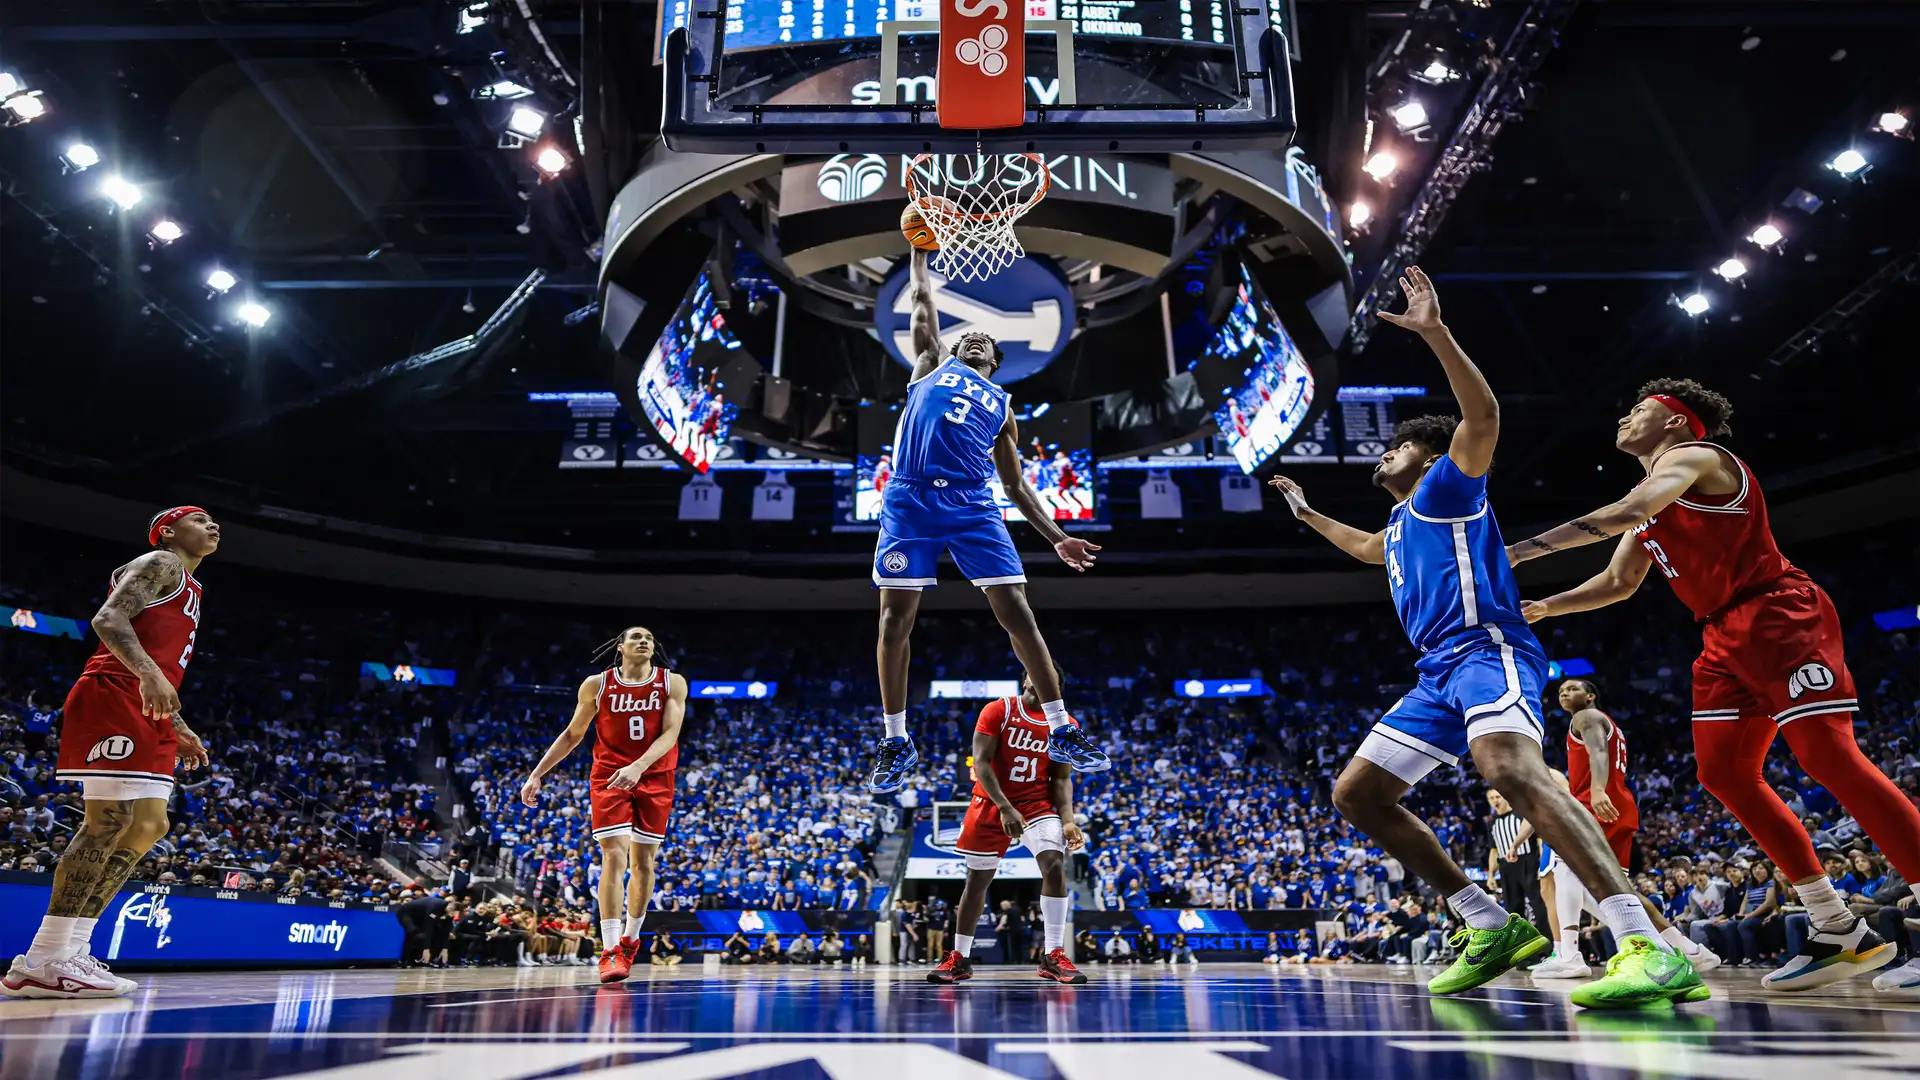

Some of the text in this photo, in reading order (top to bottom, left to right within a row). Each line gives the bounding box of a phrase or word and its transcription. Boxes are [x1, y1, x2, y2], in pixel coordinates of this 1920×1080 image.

[906, 7, 923, 17] 15
[1029, 7, 1046, 17] 15
[935, 372, 999, 413] BYU
[944, 396, 972, 424] 3
[693, 489, 708, 500] 11
[1803, 668, 1828, 687] U
[608, 690, 661, 713] Utah
[629, 715, 644, 740] 8
[1007, 726, 1049, 753] Uta
[107, 739, 130, 756] U
[1009, 755, 1038, 782] 21
[288, 919, 348, 952] smarty
